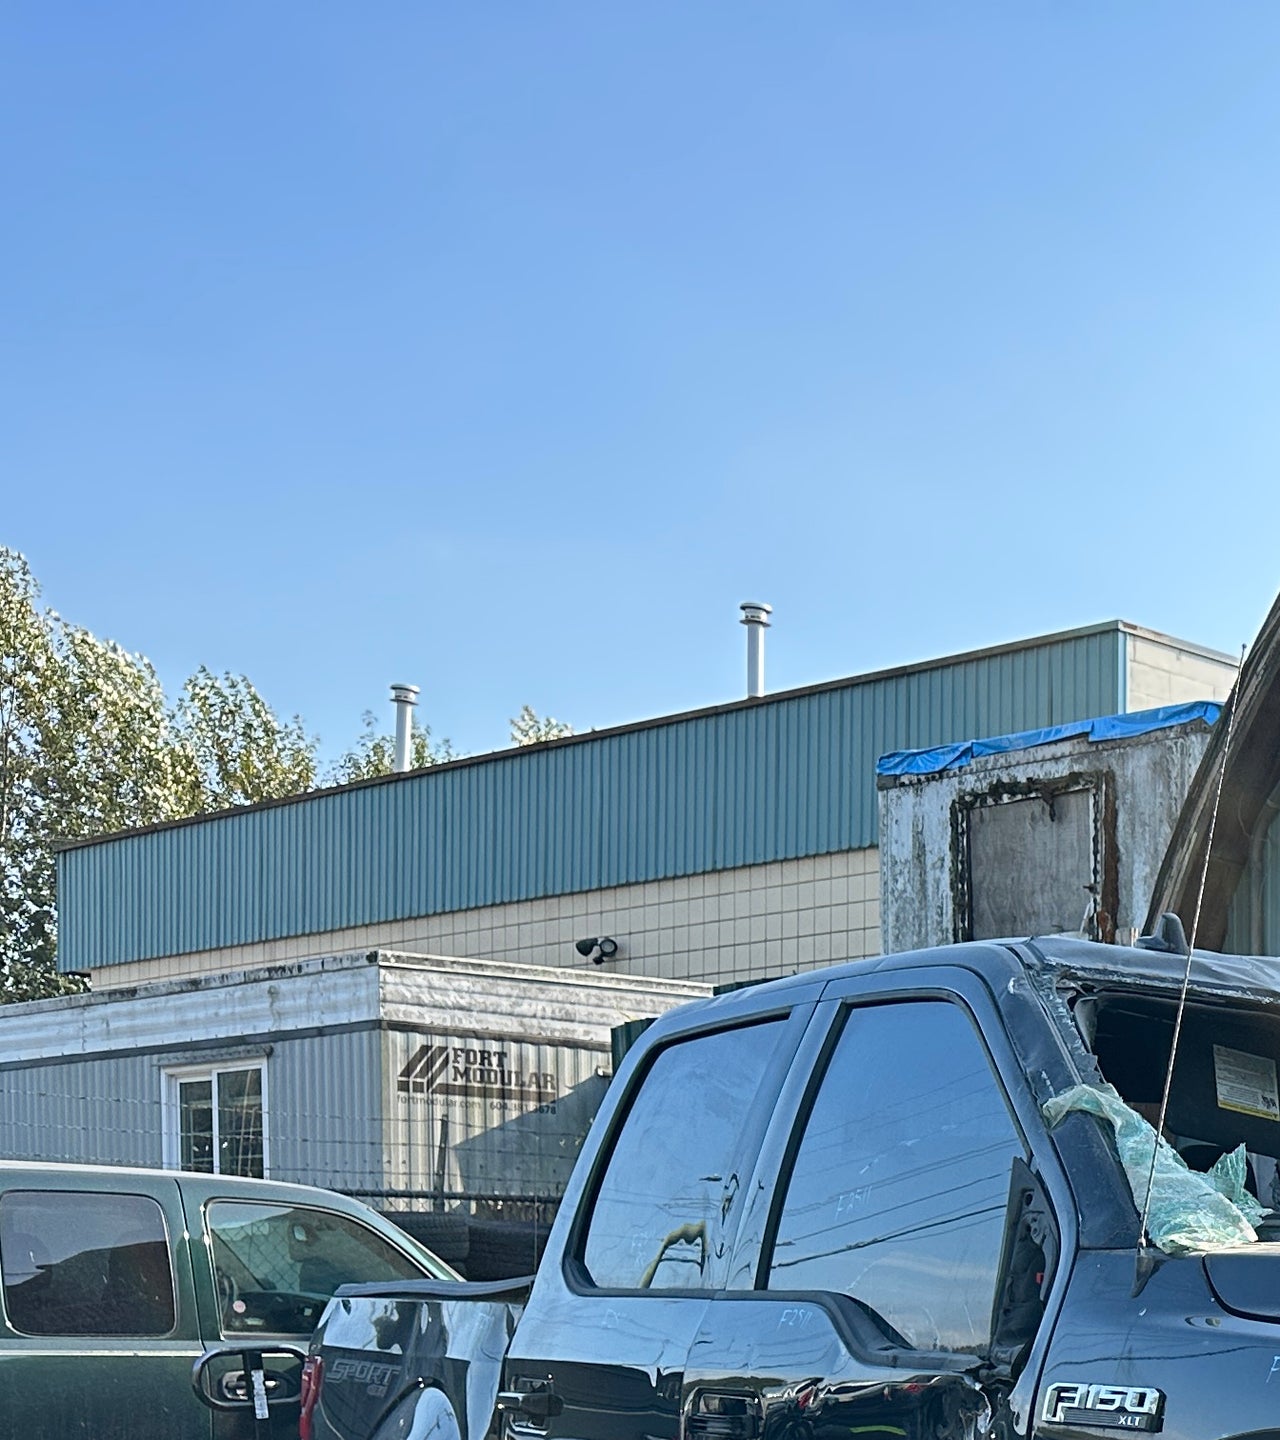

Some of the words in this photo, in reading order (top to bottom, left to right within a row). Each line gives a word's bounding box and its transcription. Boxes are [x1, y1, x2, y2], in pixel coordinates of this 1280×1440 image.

[452, 1047, 508, 1067] FORT
[452, 1066, 556, 1091] MODULAR
[325, 1358, 402, 1386] SPORT
[1117, 1414, 1143, 1427] XLT
